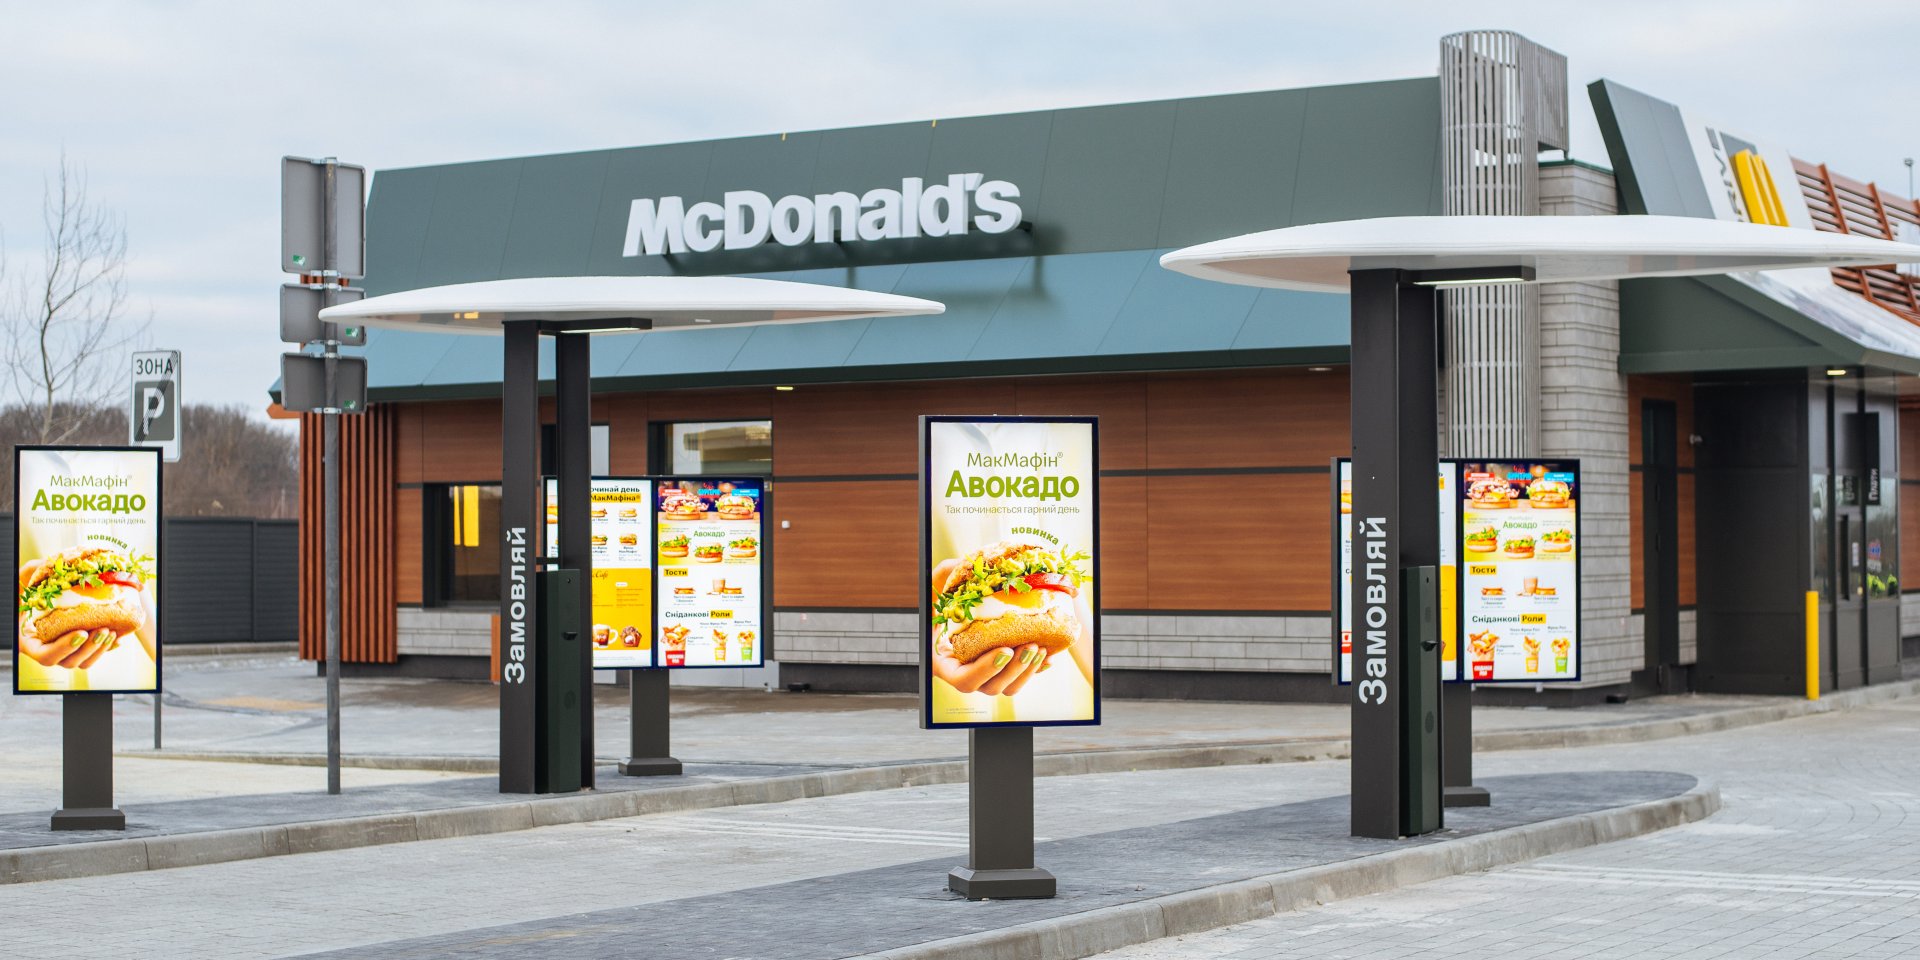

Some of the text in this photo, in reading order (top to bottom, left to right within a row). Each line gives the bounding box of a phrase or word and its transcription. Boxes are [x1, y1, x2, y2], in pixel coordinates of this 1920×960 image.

[1705, 126, 1743, 222] RIVE
[622, 172, 1022, 257] McDonald's
[136, 358, 173, 375] ЗОНА
[591, 485, 619, 493] очинай
[945, 470, 1080, 501] Авокадо
[31, 489, 146, 514] Авокадо
[945, 504, 1080, 515] Так починається гарний день
[1502, 521, 1538, 529] Авокадо
[87, 534, 128, 549] новинка
[693, 530, 726, 538] Авокадо
[1011, 527, 1059, 545] новинка
[1471, 566, 1496, 574] Тости
[504, 527, 526, 684] Замовляй
[1358, 517, 1387, 705] Замовляй
[665, 610, 709, 619] Сніданкові
[1472, 614, 1520, 623] Сніданкові
